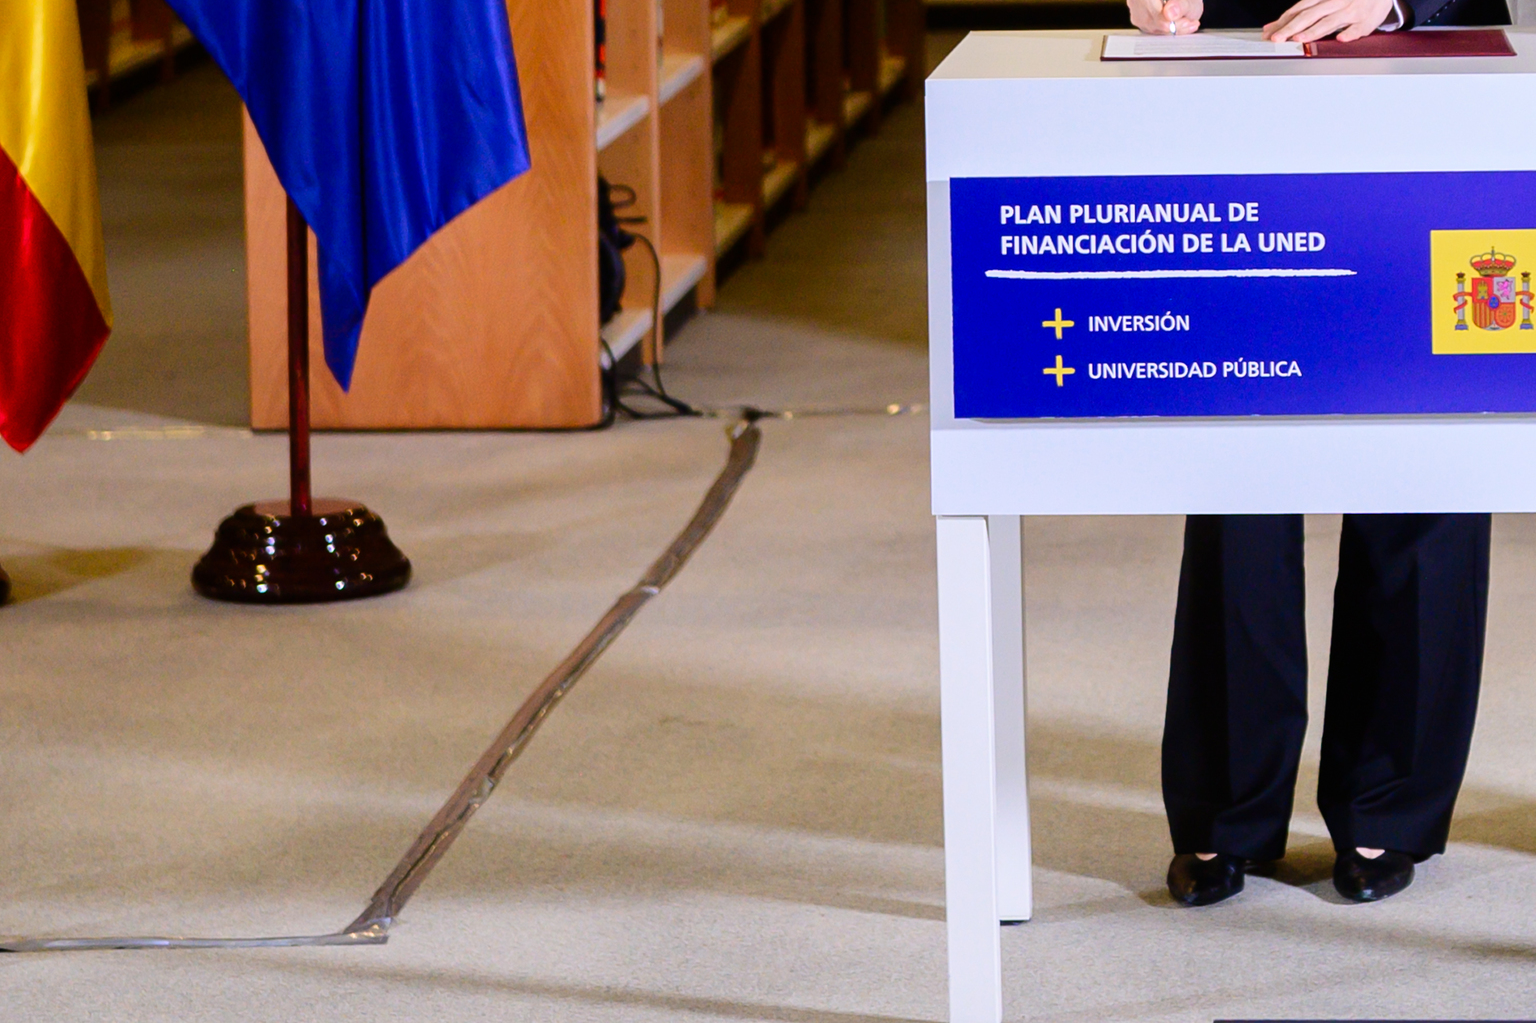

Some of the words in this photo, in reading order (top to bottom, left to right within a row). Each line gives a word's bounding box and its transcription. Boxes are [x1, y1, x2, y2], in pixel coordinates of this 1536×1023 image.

[1000, 204, 1062, 225] PLAN
[1069, 202, 1222, 224] PLURIANUAL
[1228, 202, 1259, 222] DE
[1001, 229, 1175, 256] FINANCIACIÓN
[1182, 233, 1214, 253] DE
[1220, 232, 1252, 253] LA
[1258, 232, 1326, 253] UNED
[1088, 310, 1190, 332] INVERSIÓN
[1088, 361, 1217, 380] UNIVERSIDAD
[1222, 357, 1303, 378] PÚBLICA
